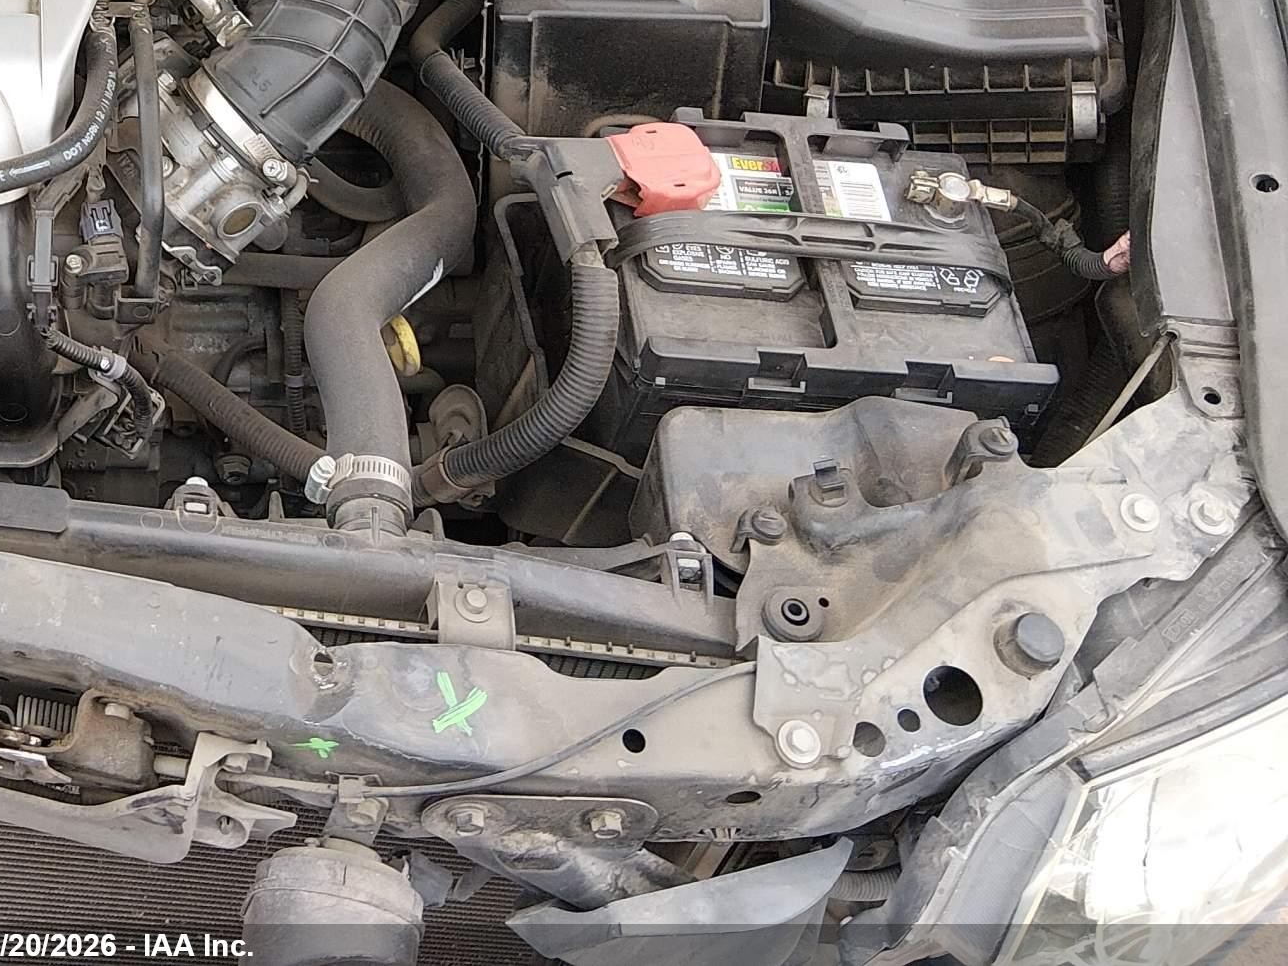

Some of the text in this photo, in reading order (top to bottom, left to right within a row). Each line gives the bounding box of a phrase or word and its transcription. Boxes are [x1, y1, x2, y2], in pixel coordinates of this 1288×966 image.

[63, 142, 83, 161] DOT
[81, 122, 100, 146] NCRN
[738, 185, 762, 194] VALUE
